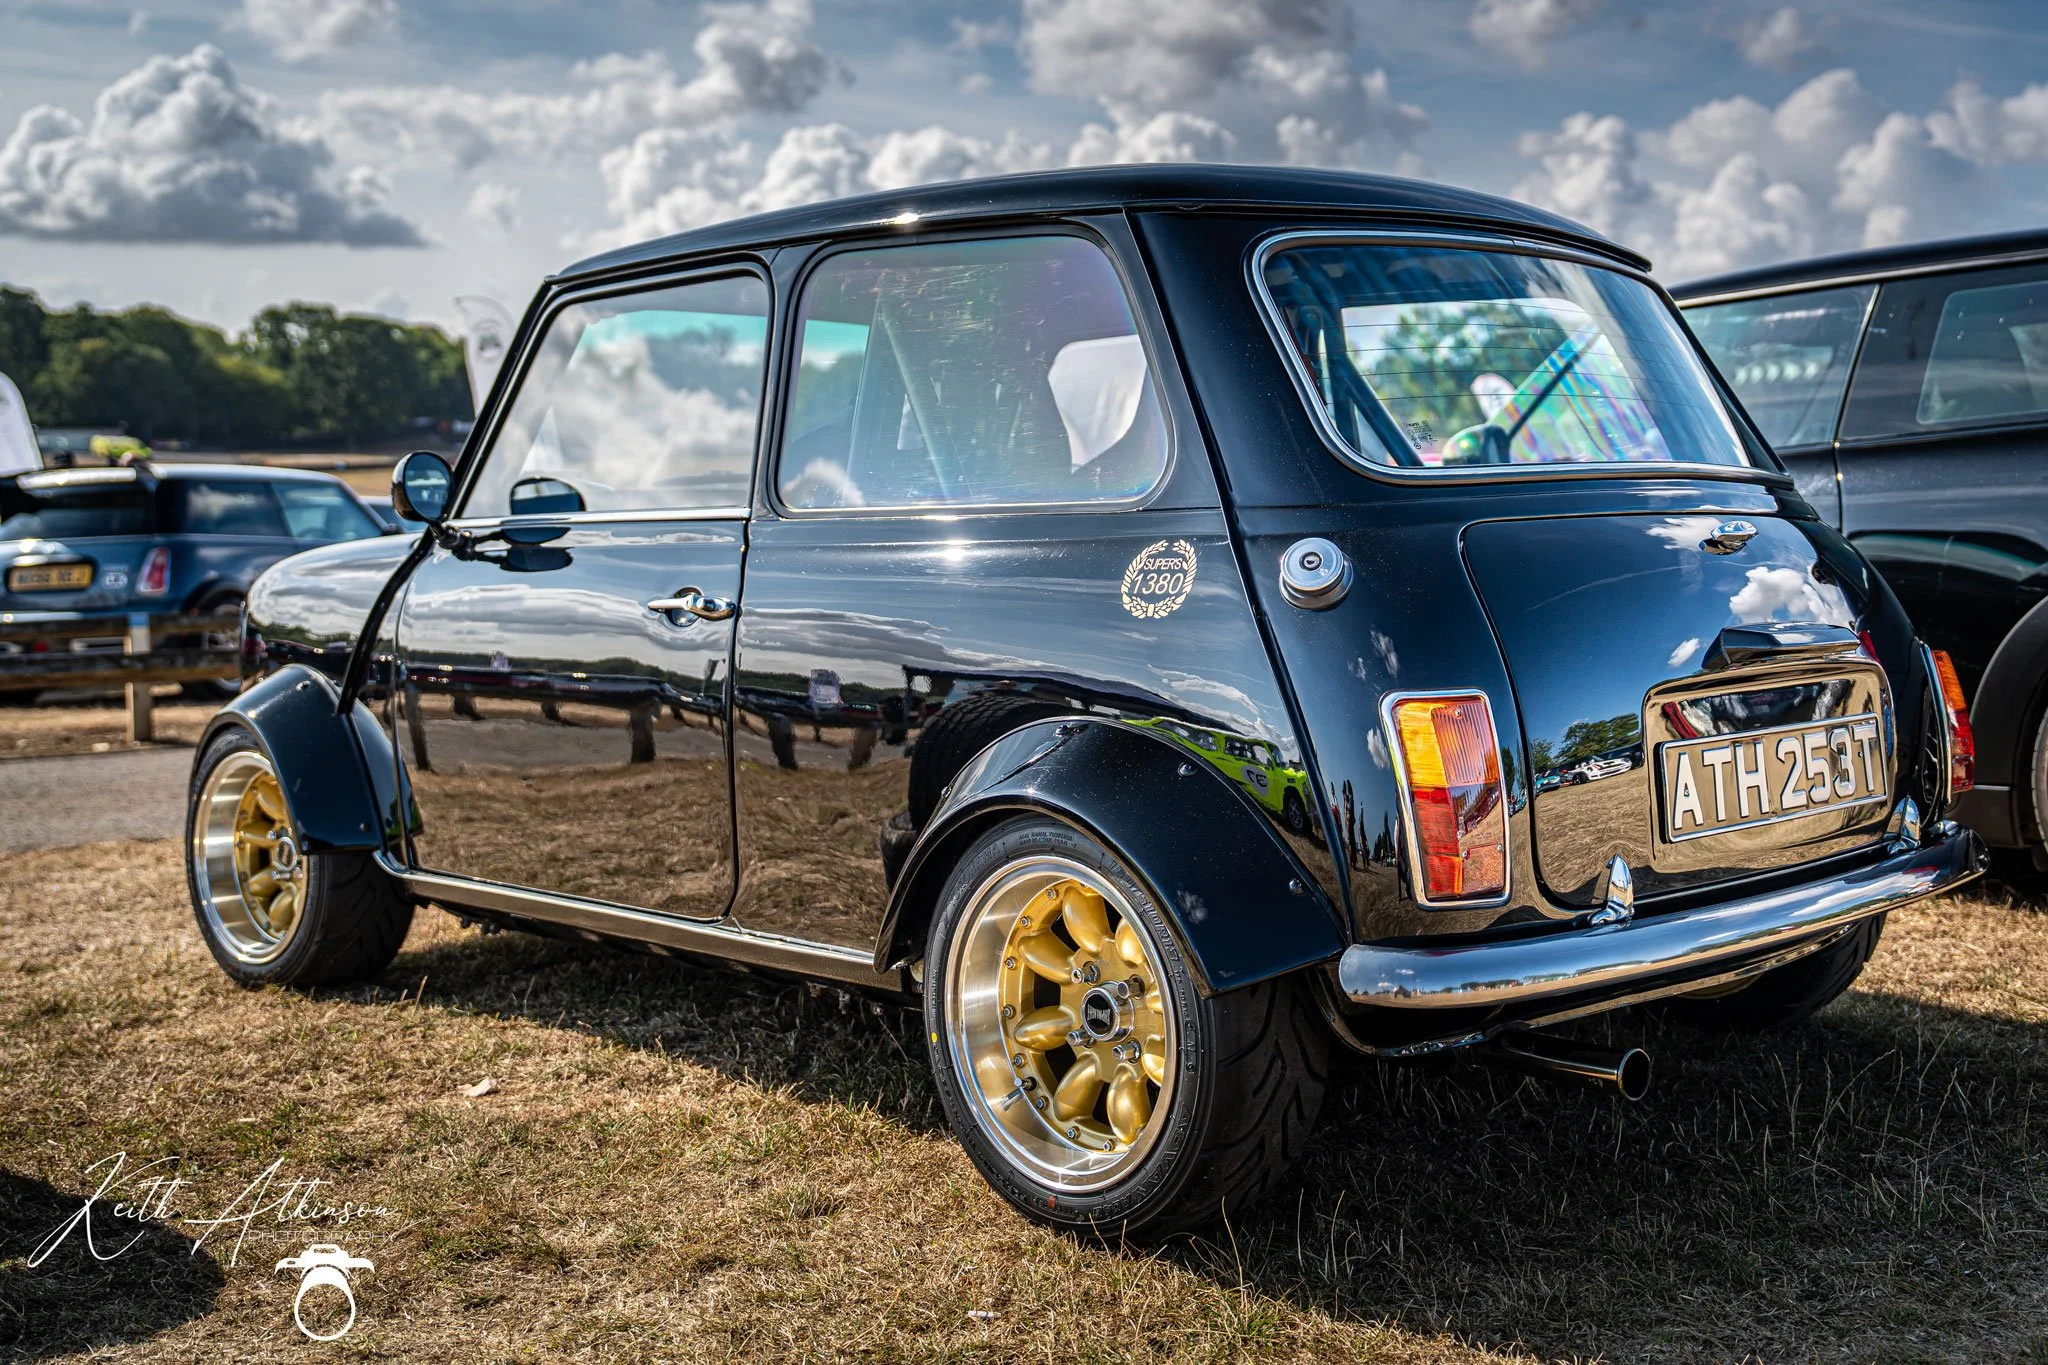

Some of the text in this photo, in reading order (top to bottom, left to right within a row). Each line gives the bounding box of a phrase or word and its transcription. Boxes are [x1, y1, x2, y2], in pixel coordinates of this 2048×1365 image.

[1133, 572, 1184, 595] 1380
[1673, 721, 1877, 830] ATH 253T
